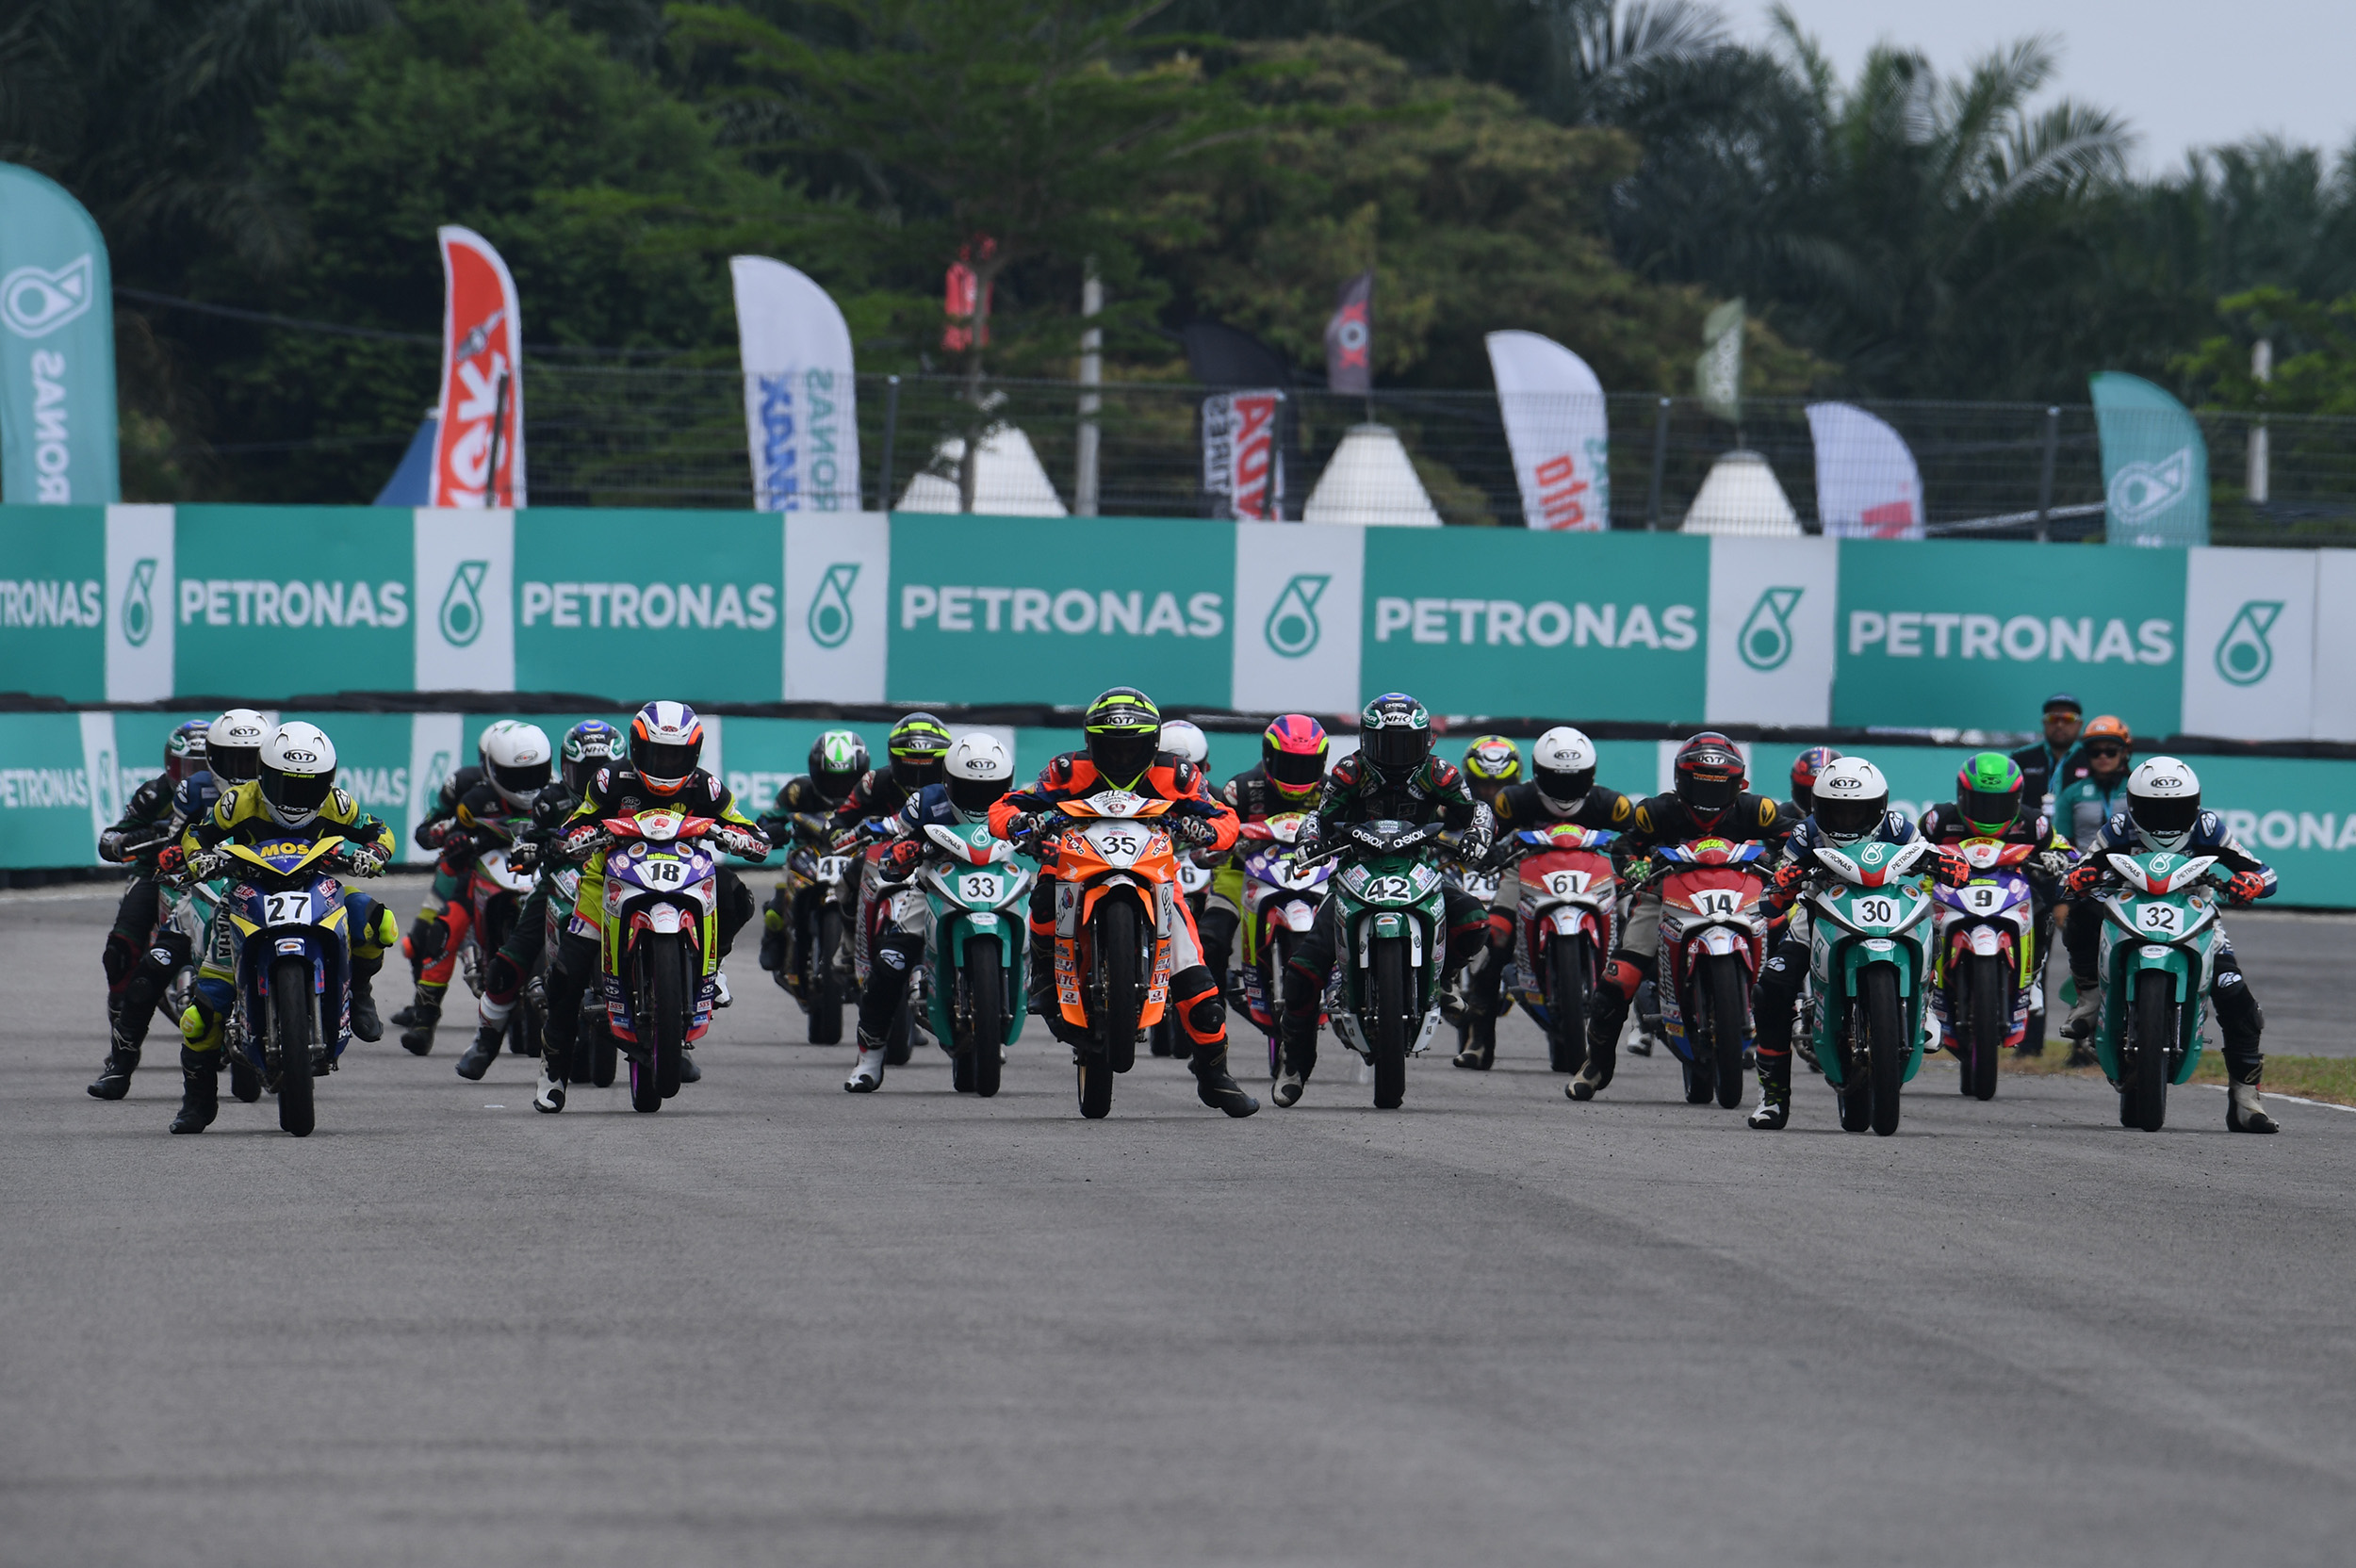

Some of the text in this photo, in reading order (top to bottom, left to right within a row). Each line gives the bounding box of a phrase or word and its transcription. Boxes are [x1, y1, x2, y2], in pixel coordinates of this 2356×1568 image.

[180, 580, 408, 629] PETRONAS
[521, 581, 777, 629] PETRONAS
[901, 584, 1224, 638] PETRONAS
[1375, 596, 1698, 651] PETRONAS
[1849, 611, 2175, 665] PETRONAS
[232, 727, 259, 736] KYT
[1106, 715, 1136, 726] KYT
[286, 750, 316, 761] KYT
[907, 740, 933, 750] KYT
[968, 760, 995, 770] KYT
[1699, 754, 1726, 764] KYT
[1831, 777, 1860, 788] KYT
[2152, 777, 2182, 787] KYT
[259, 841, 310, 858] MOS
[932, 826, 962, 851] PETRONAS
[1102, 836, 1137, 857] 35
[1351, 829, 1385, 849] ONEXOX
[1393, 829, 1427, 848] ONEXOX
[1821, 849, 1854, 873] PETRONAS
[1890, 844, 1922, 872] PETRONAS
[2113, 855, 2142, 878] PETRONAS
[650, 862, 680, 882] 18
[2175, 858, 2209, 882] PETRONAS
[967, 876, 995, 899] 33
[1366, 876, 1410, 902] 42
[1552, 874, 1580, 894] 61
[266, 895, 310, 923] 27
[1702, 894, 1734, 916] 14
[1975, 890, 1992, 906] 9
[1861, 900, 1891, 923] 30
[2145, 906, 2175, 931] 32
